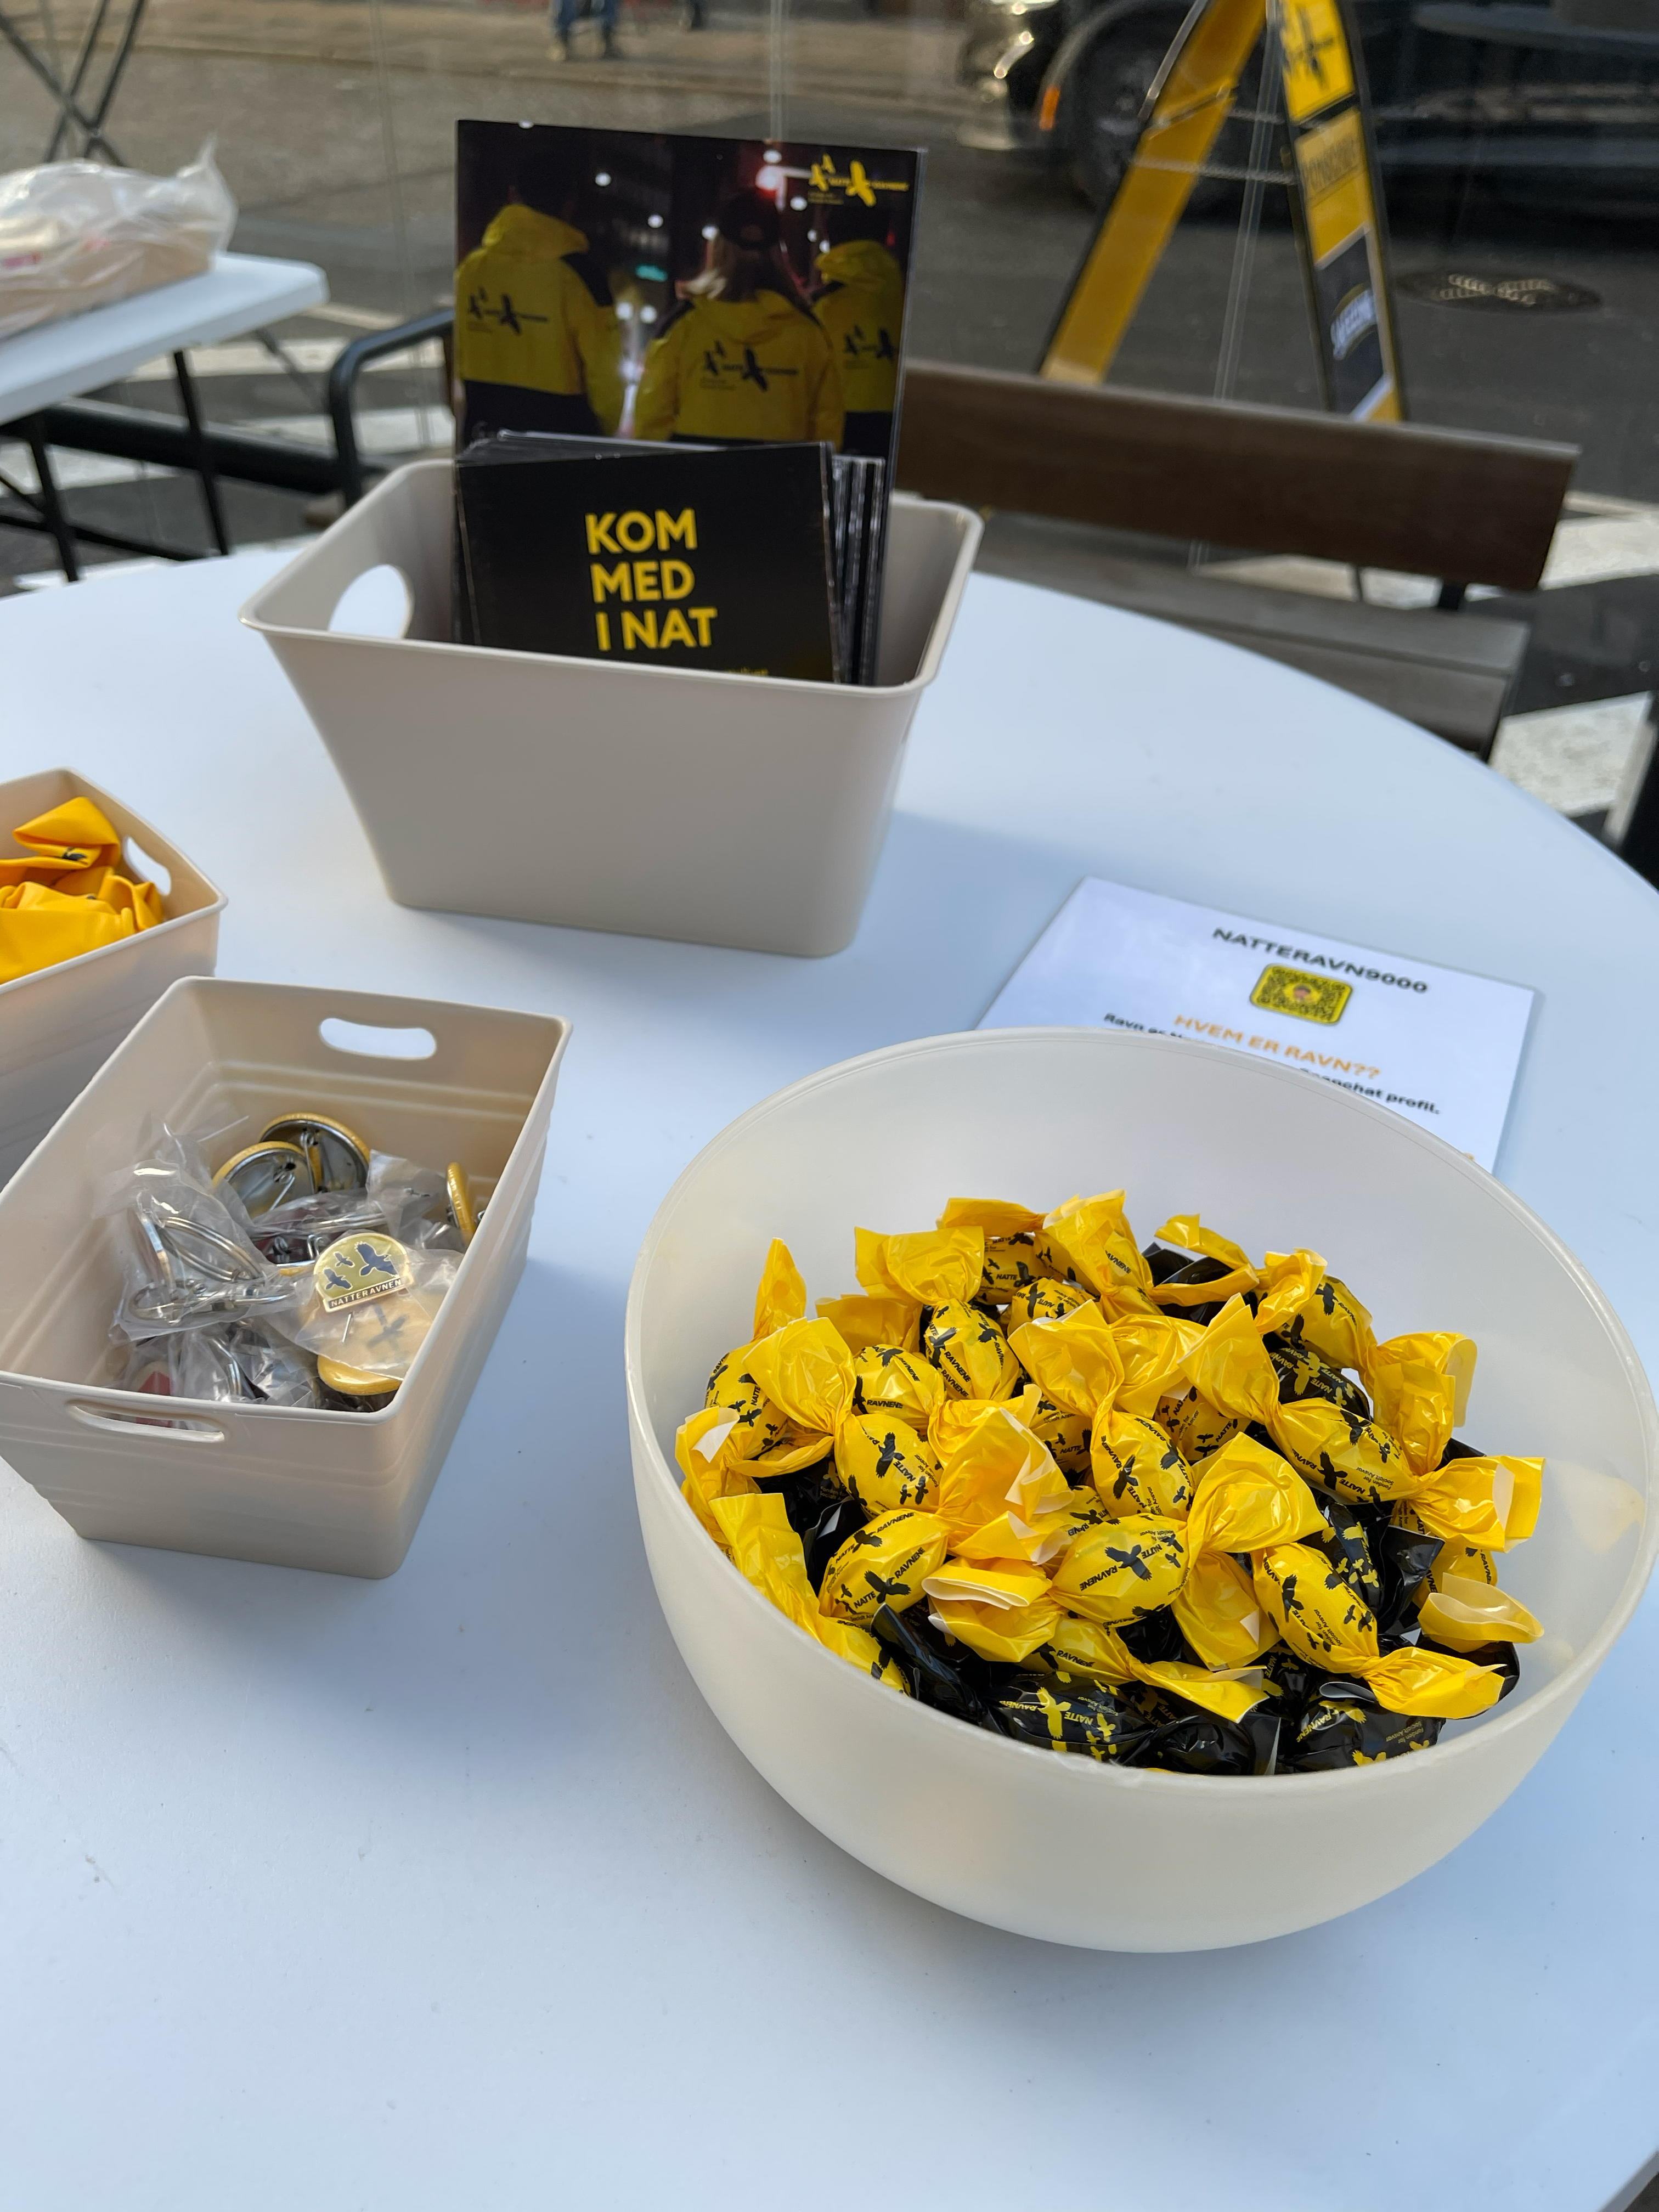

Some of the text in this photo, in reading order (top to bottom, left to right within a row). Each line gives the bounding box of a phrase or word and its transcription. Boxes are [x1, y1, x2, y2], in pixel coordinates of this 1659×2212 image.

[585, 508, 698, 555] KOM
[590, 560, 696, 603] MED
[596, 607, 718, 651] I NAT
[1212, 927, 1430, 994] NATTERAVN9000
[1174, 1014, 1381, 1080] HVEM ER RAVN??
[1104, 1012, 1145, 1031] Ravn
[1385, 1093, 1441, 1115] profil.
[331, 1279, 402, 1307] NATTERAVNEN
[944, 1351, 972, 1383] RAVNENE
[941, 1369, 969, 1397] RAVNENE
[1311, 1378, 1332, 1393] NATTE
[751, 1386, 761, 1406] NATTE
[867, 1400, 904, 1409] RAVNENE
[1215, 1421, 1232, 1442] NATTE
[1060, 1444, 1082, 1454] NATTE
[893, 1460, 916, 1482] NATTE
[1356, 1466, 1375, 1479] Ansvar
[1339, 1479, 1365, 1494] NATTE
[1372, 1480, 1391, 1491] Fonden
[1127, 1486, 1147, 1509] NATTE
[877, 1512, 915, 1533] RAVNENE
[854, 1547, 926, 1609] NATTE RAVNENE
[1079, 1565, 1118, 1592] RAVNENE
[1314, 1609, 1329, 1628] Ansvar
[1057, 1650, 1096, 1667] RAVNENE
[1265, 1656, 1277, 1678] NATTE
[1064, 1711, 1093, 1725] NATTE
[1144, 1714, 1163, 1728] ATTE
[1159, 1705, 1177, 1720] ATTE
